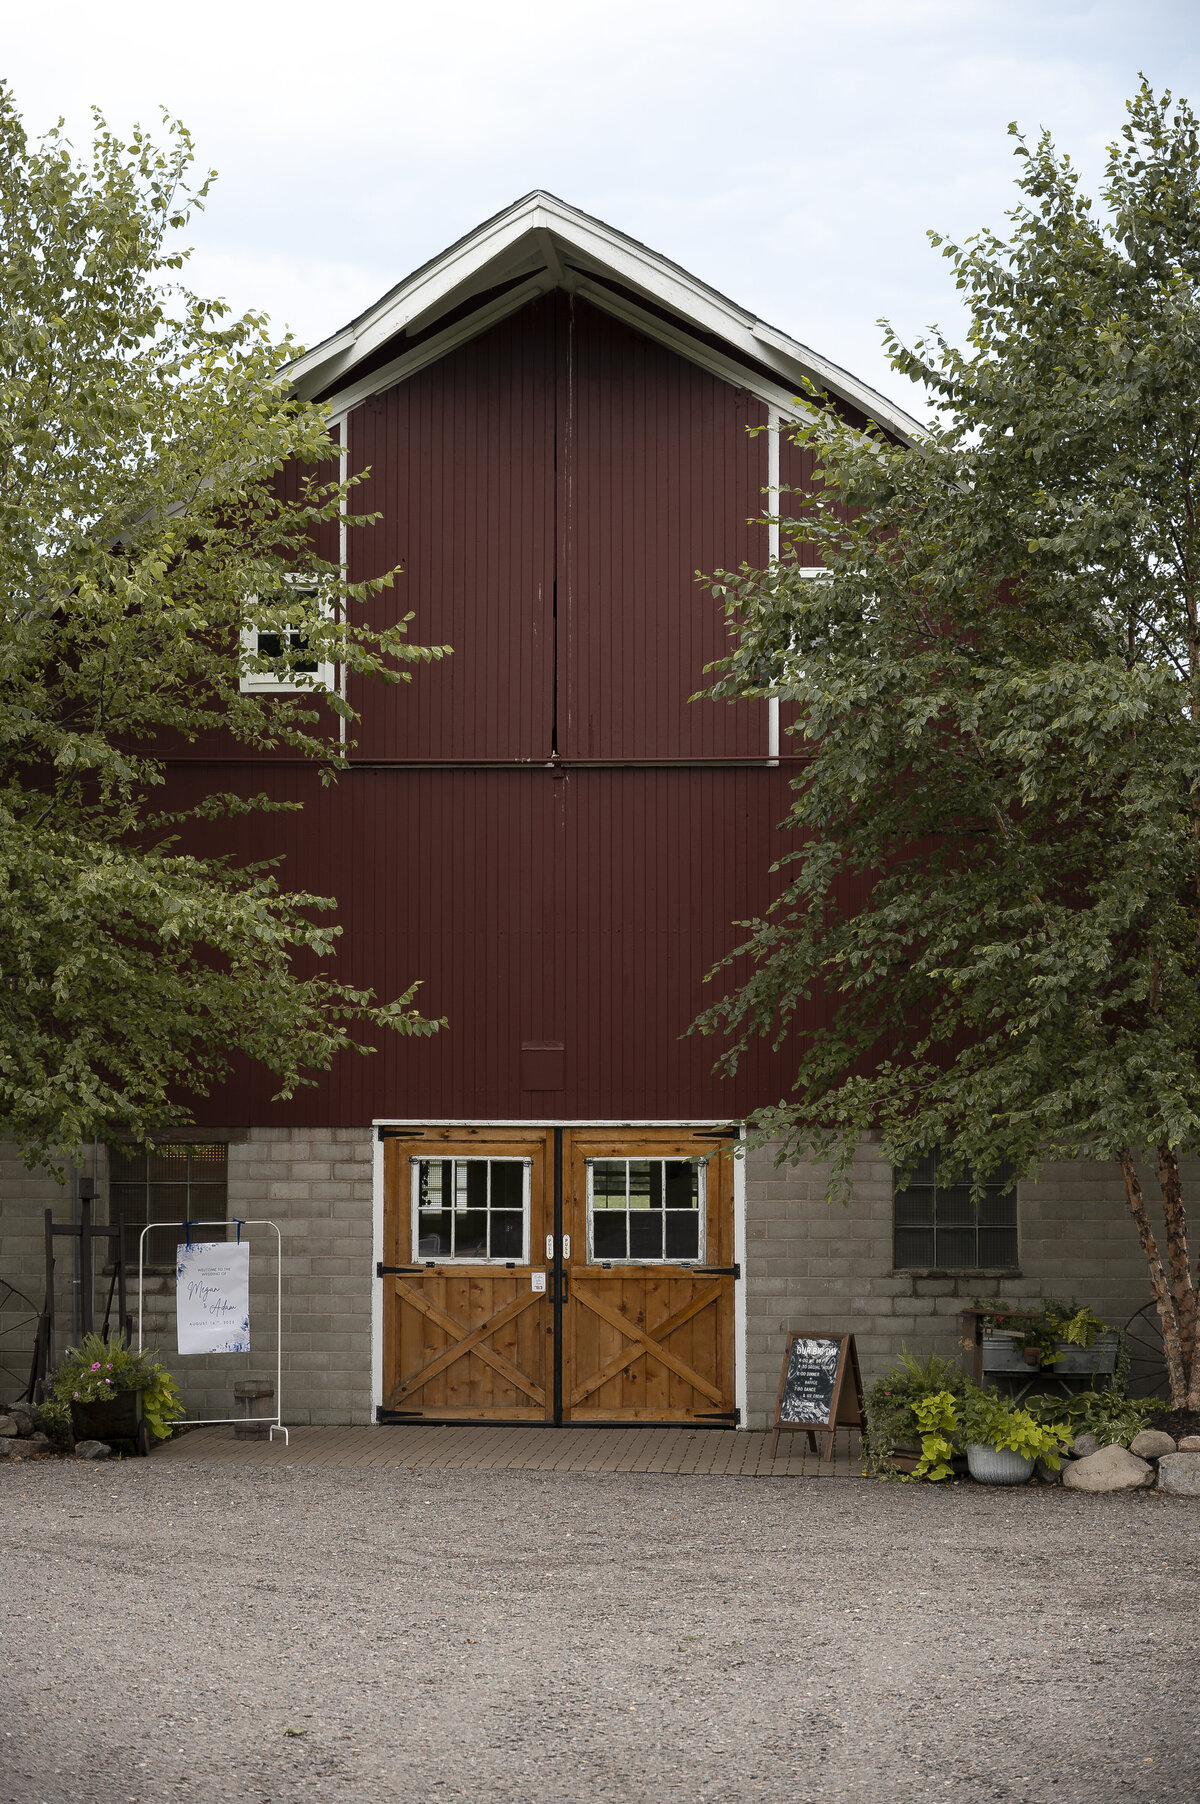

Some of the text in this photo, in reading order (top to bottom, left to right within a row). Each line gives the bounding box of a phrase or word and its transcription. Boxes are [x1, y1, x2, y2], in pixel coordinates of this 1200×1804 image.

[187, 1281, 220, 1302] Megan
[209, 1298, 237, 1317] Adam
[796, 1347, 838, 1356] OUR BIG DAY
